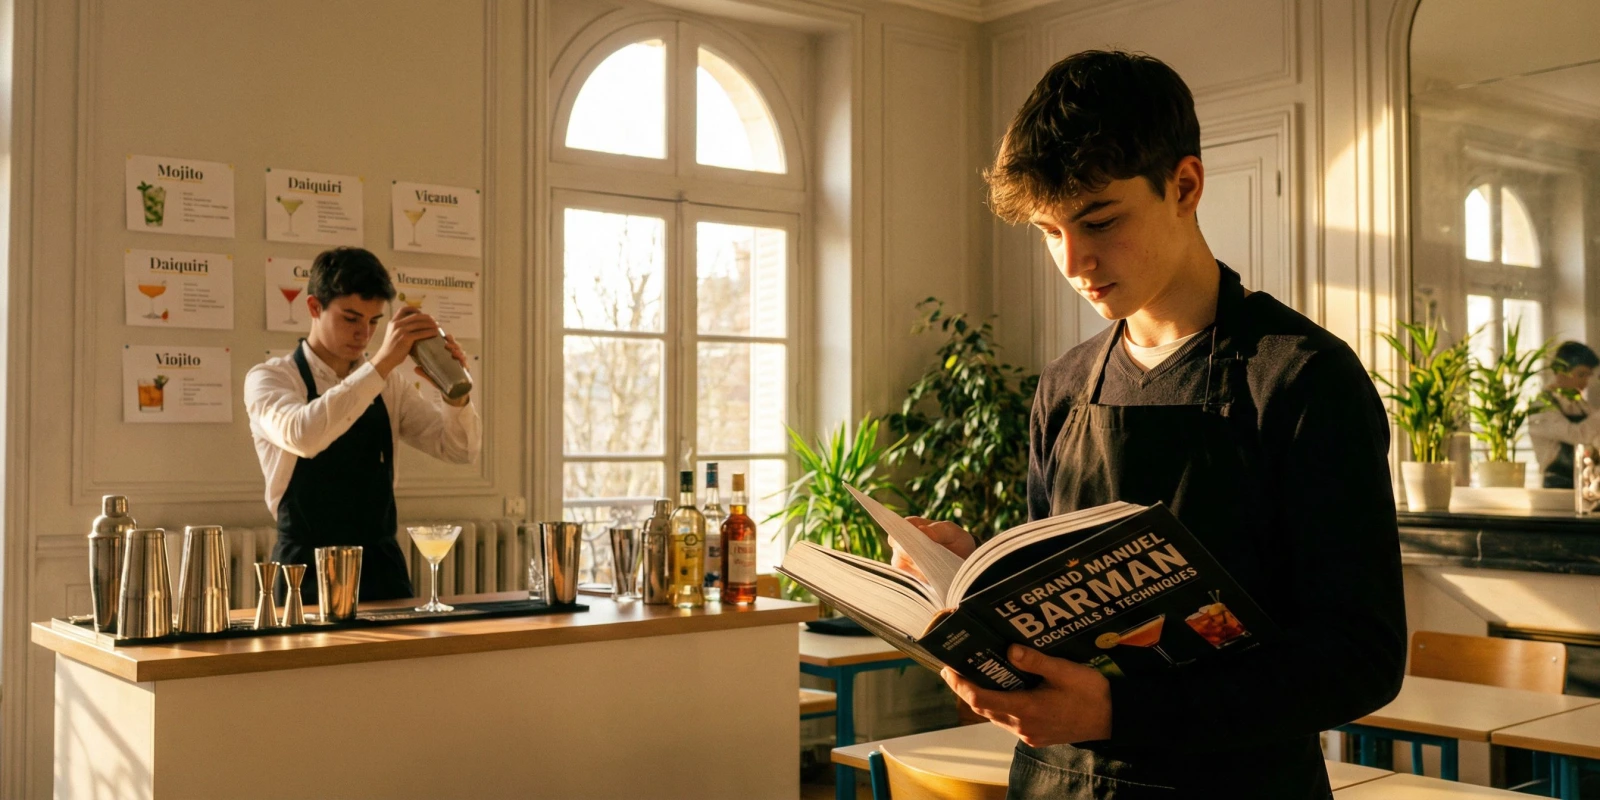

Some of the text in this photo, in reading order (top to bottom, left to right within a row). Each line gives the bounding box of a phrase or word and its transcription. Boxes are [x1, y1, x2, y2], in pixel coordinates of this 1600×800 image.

[158, 164, 204, 181] Mojito
[288, 176, 342, 194] Daiquiri
[150, 256, 209, 274] Daiquiri
[155, 352, 202, 368] Viojito
[994, 531, 1166, 619] LE GRAND MANUEL
[1008, 543, 1190, 639] BARMAN
[1033, 566, 1199, 648] COCKTAILS & TECHNIQUES
